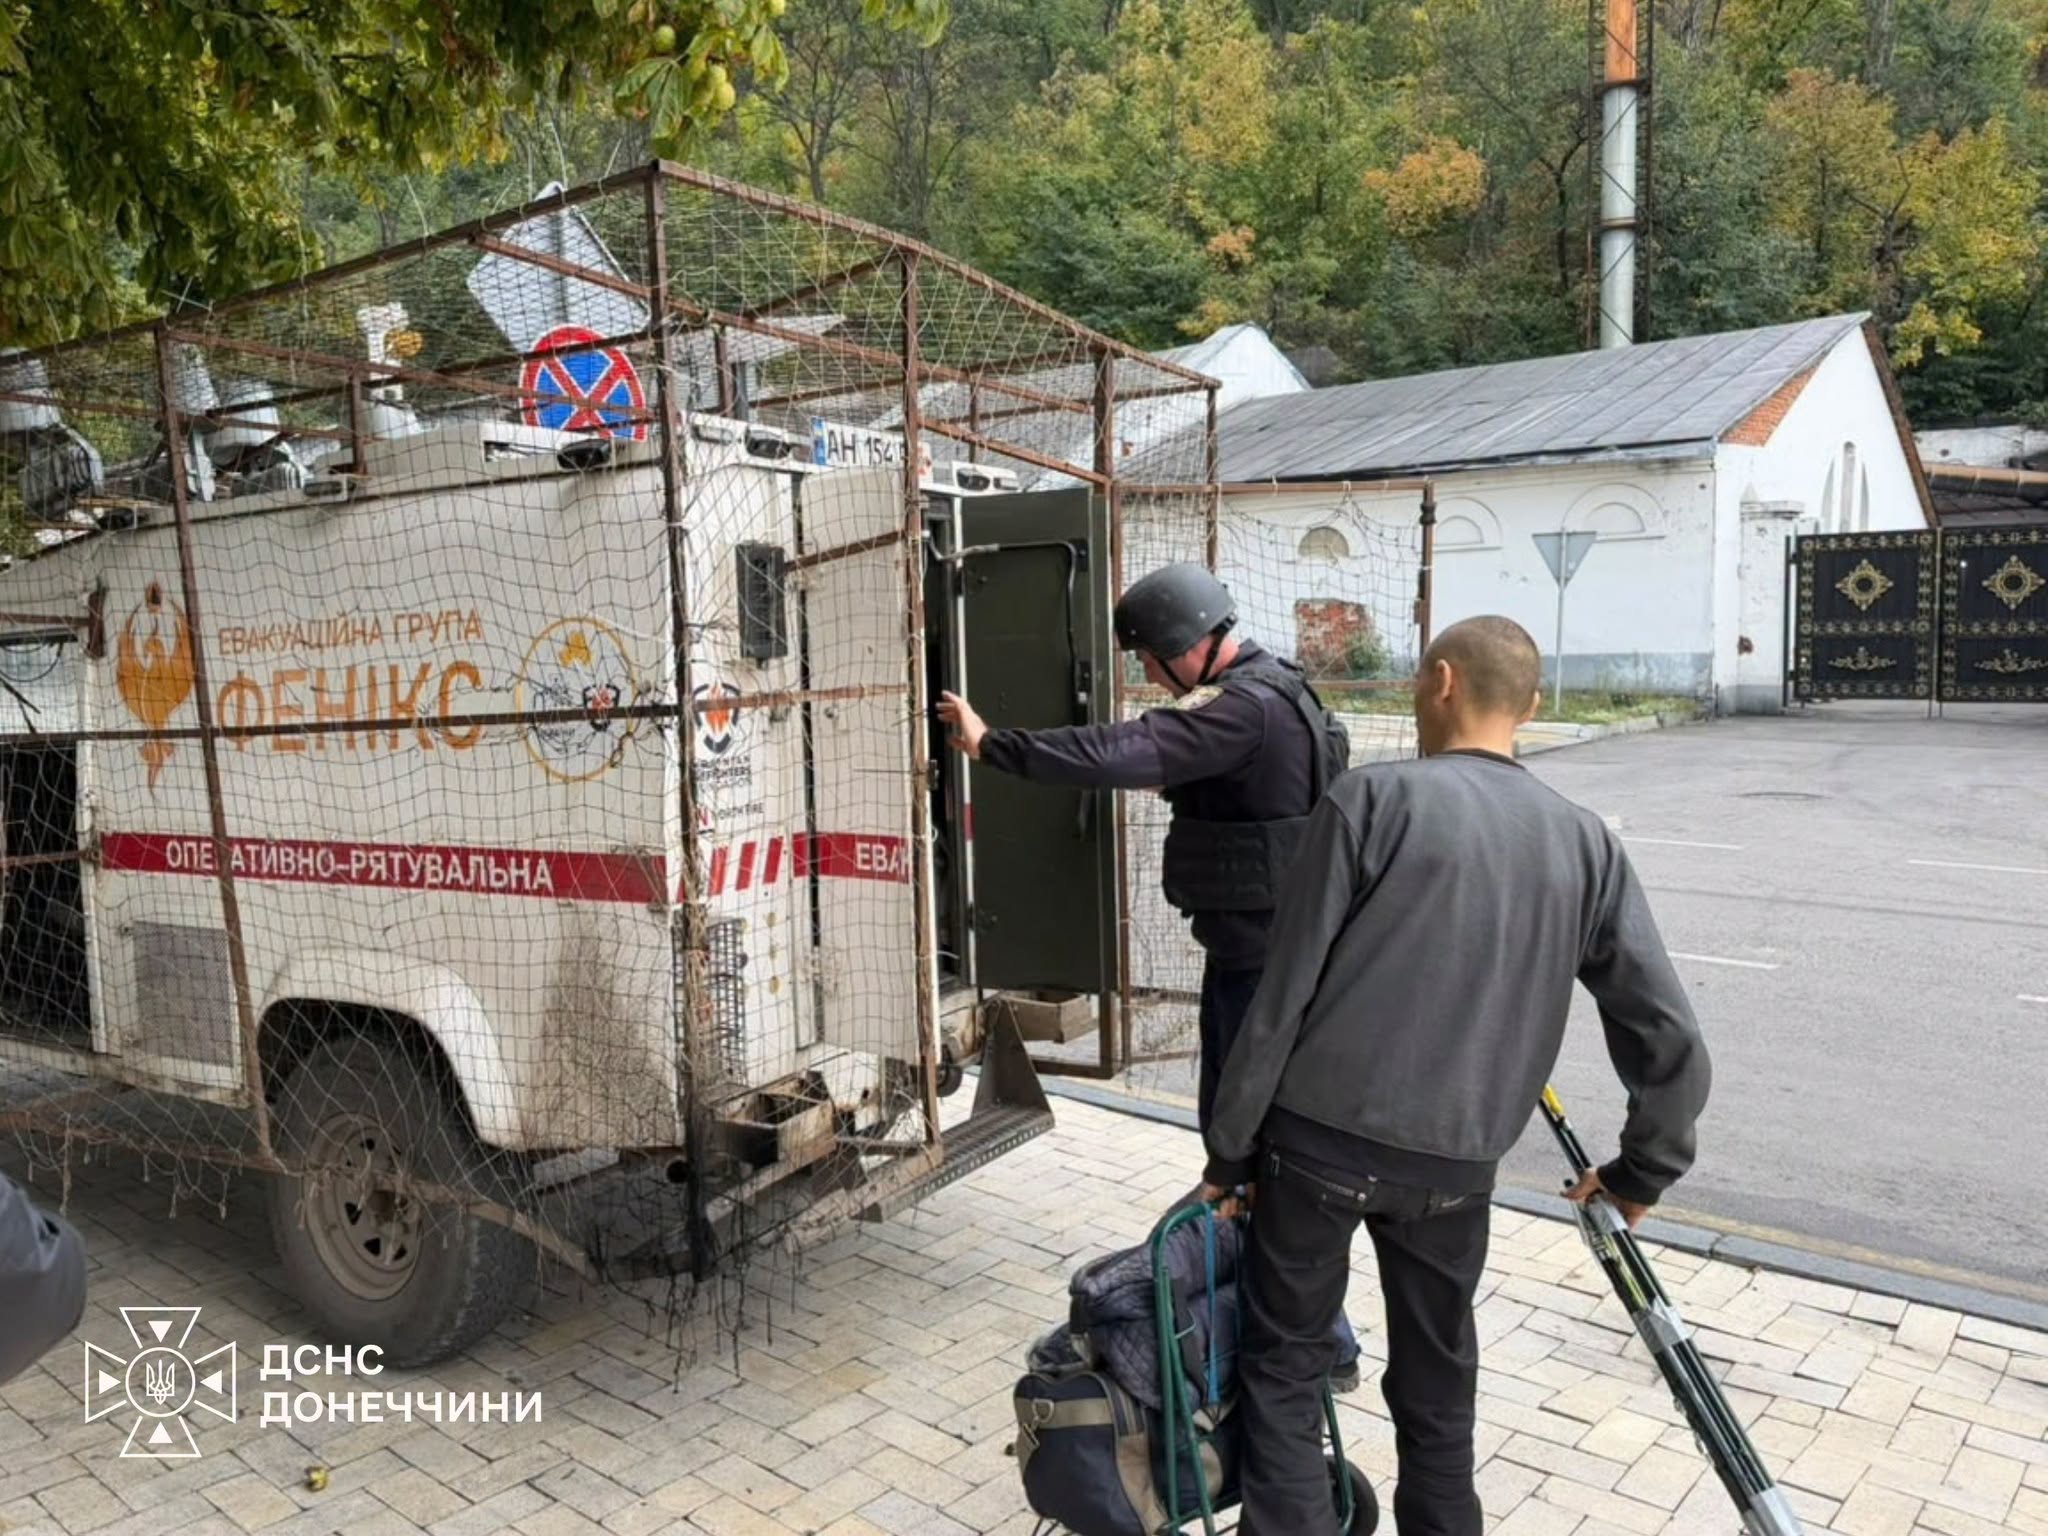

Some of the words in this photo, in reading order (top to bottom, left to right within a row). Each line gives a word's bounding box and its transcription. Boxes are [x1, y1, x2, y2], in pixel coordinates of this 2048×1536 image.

[828, 429, 857, 465] AH
[864, 435, 906, 466] 154
[218, 611, 384, 656] ЕВАКУАЦІЙНА
[392, 607, 484, 644] ГРУПА
[216, 660, 484, 753] ФЕНІКС
[165, 839, 554, 892] ОПЕАТИВНО-РЯТУВАЛЬНА
